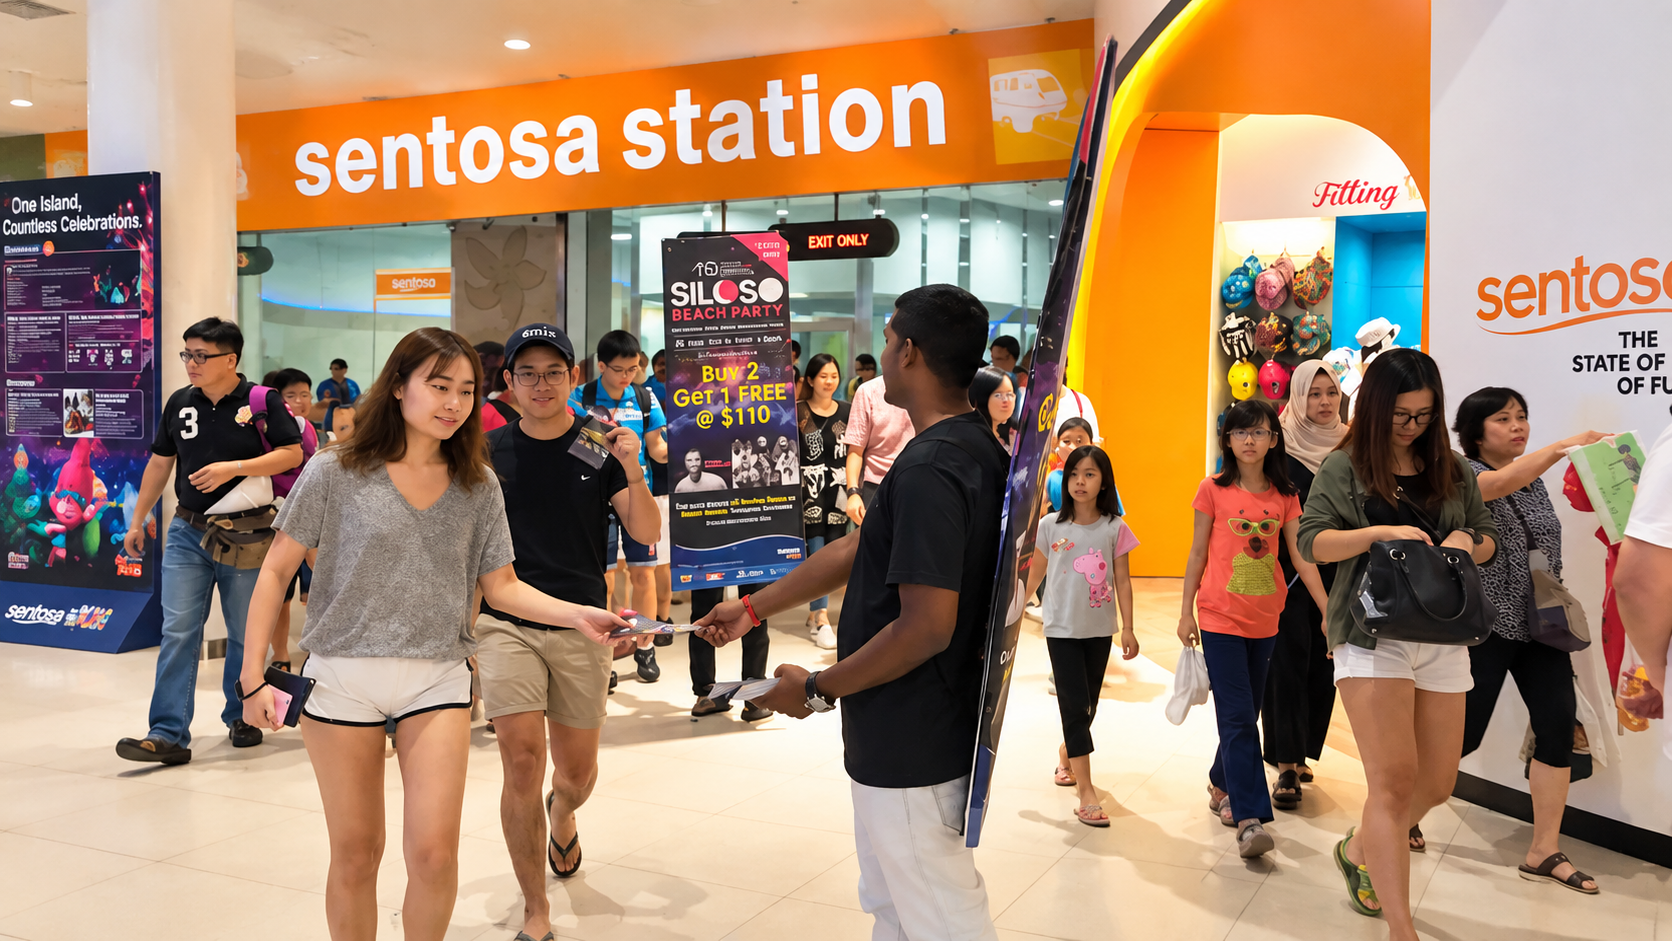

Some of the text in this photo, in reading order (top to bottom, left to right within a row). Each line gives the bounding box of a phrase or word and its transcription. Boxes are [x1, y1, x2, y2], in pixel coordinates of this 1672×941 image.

[295, 73, 946, 197] sentosa station
[11, 193, 82, 215] One Island,
[1312, 178, 1399, 211] Fitting
[2, 212, 143, 236] Countless Celebrations.
[807, 233, 869, 249] EXIT ONLY
[391, 276, 436, 290] sentosa
[670, 277, 784, 307] SILOSO
[1476, 255, 1672, 321] sentos
[672, 303, 783, 322] BEACH PARTY
[1618, 330, 1658, 349] THE
[747, 362, 759, 380] 2
[1572, 353, 1666, 373] STATE OF
[720, 386, 730, 404] 1
[738, 383, 787, 402] FREE
[1617, 376, 1645, 395] OF
[178, 406, 199, 440] 3
[696, 404, 771, 429] @ $110
[5, 604, 65, 621] sentosa
